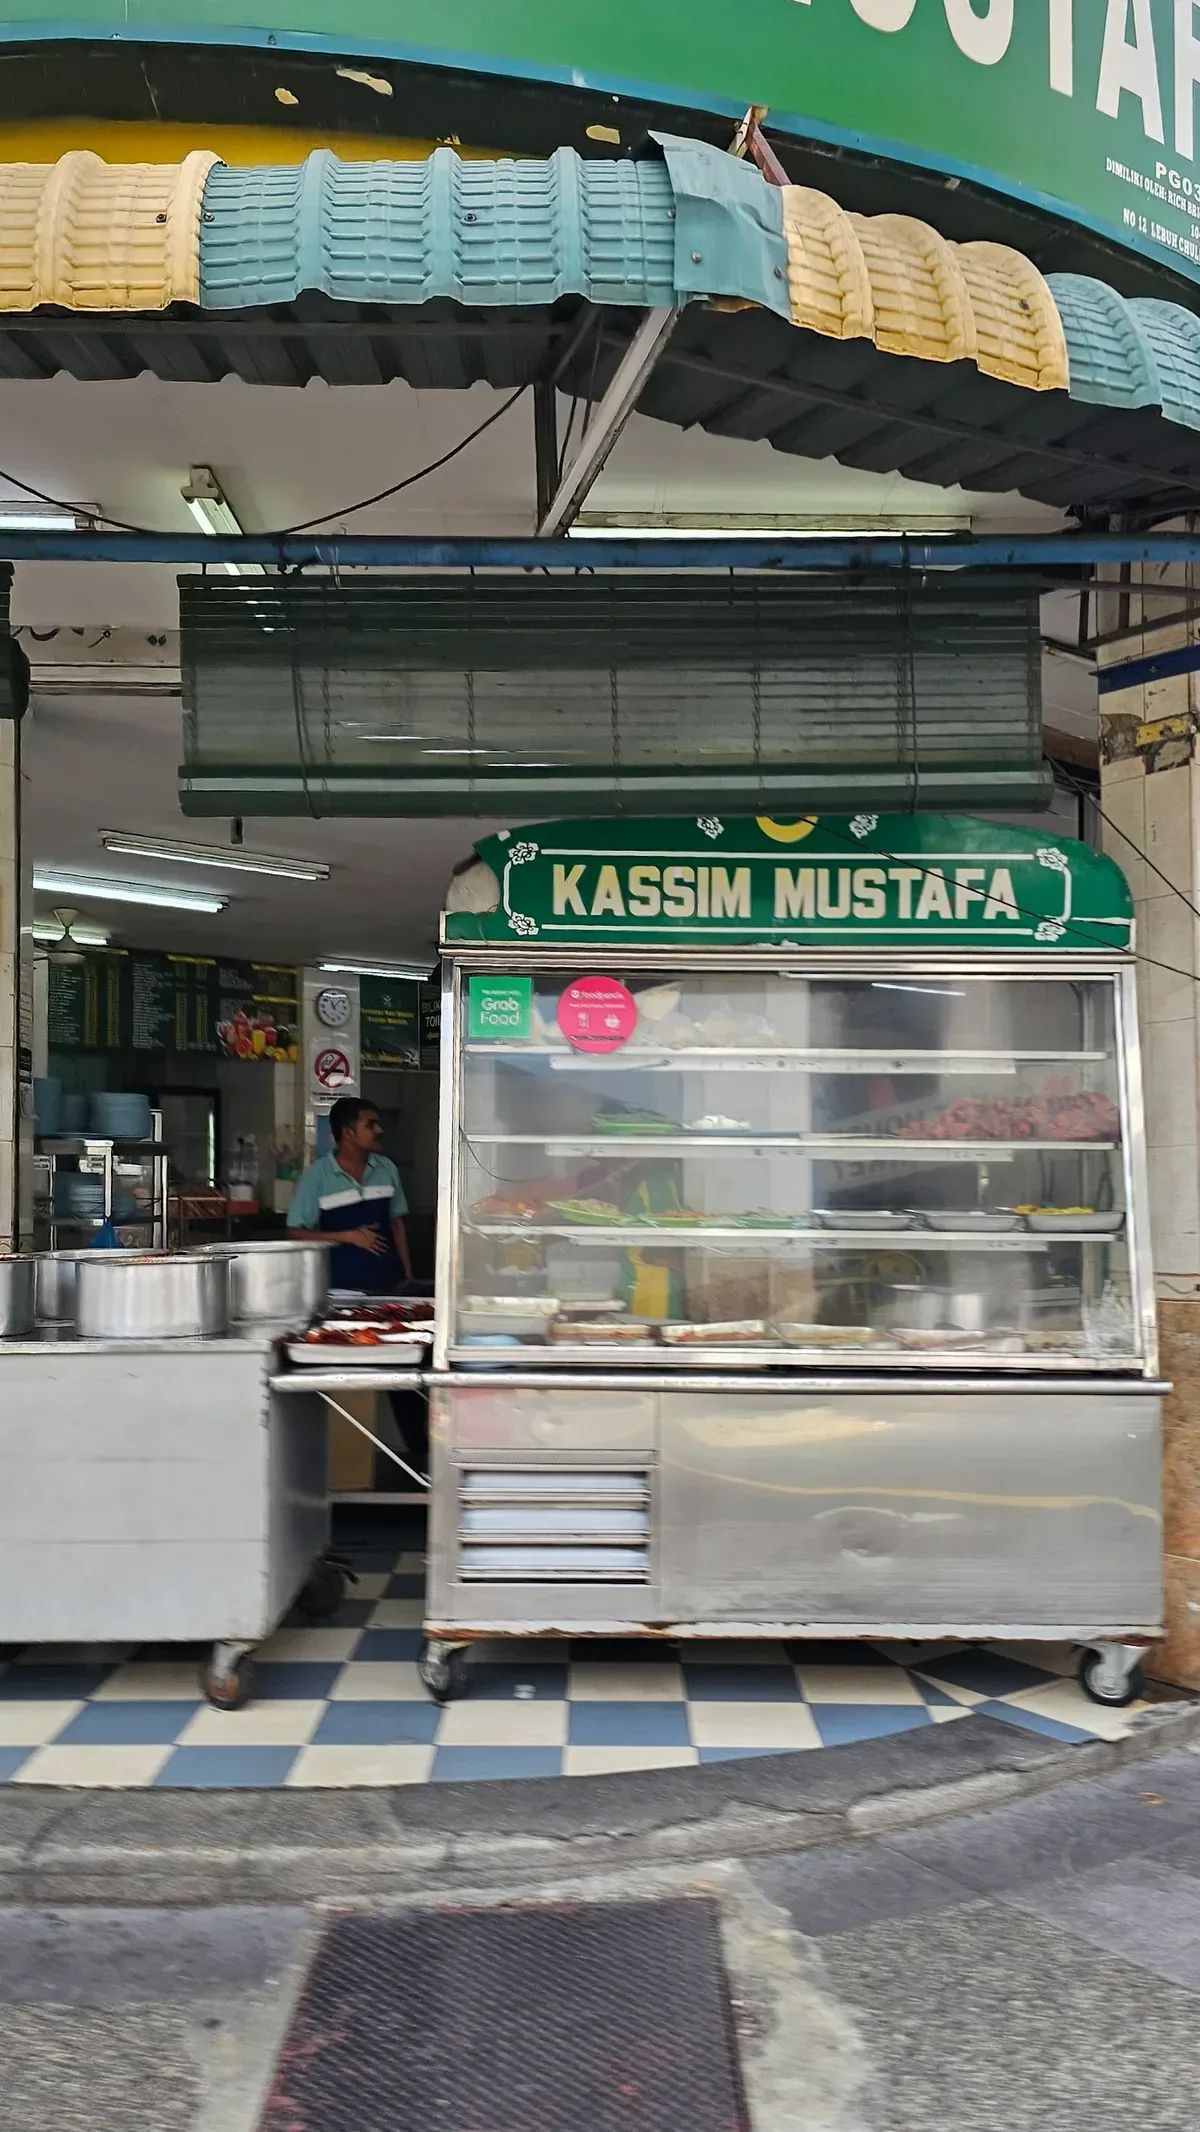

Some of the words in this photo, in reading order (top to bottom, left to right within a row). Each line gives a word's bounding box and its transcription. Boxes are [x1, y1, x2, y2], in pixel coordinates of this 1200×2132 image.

[1106, 157, 1144, 188] DIMILIKI
[1144, 177, 1167, 201] OLEH:
[1168, 190, 1187, 212] RICH
[1123, 207, 1136, 228] NO
[1138, 215, 1148, 234] 12
[1151, 221, 1178, 248] LEBUH
[552, 864, 752, 919] KASSIM
[773, 867, 1021, 920] MUSTAFA
[480, 1011, 519, 1026] Food
[481, 997, 519, 1011] Grab
